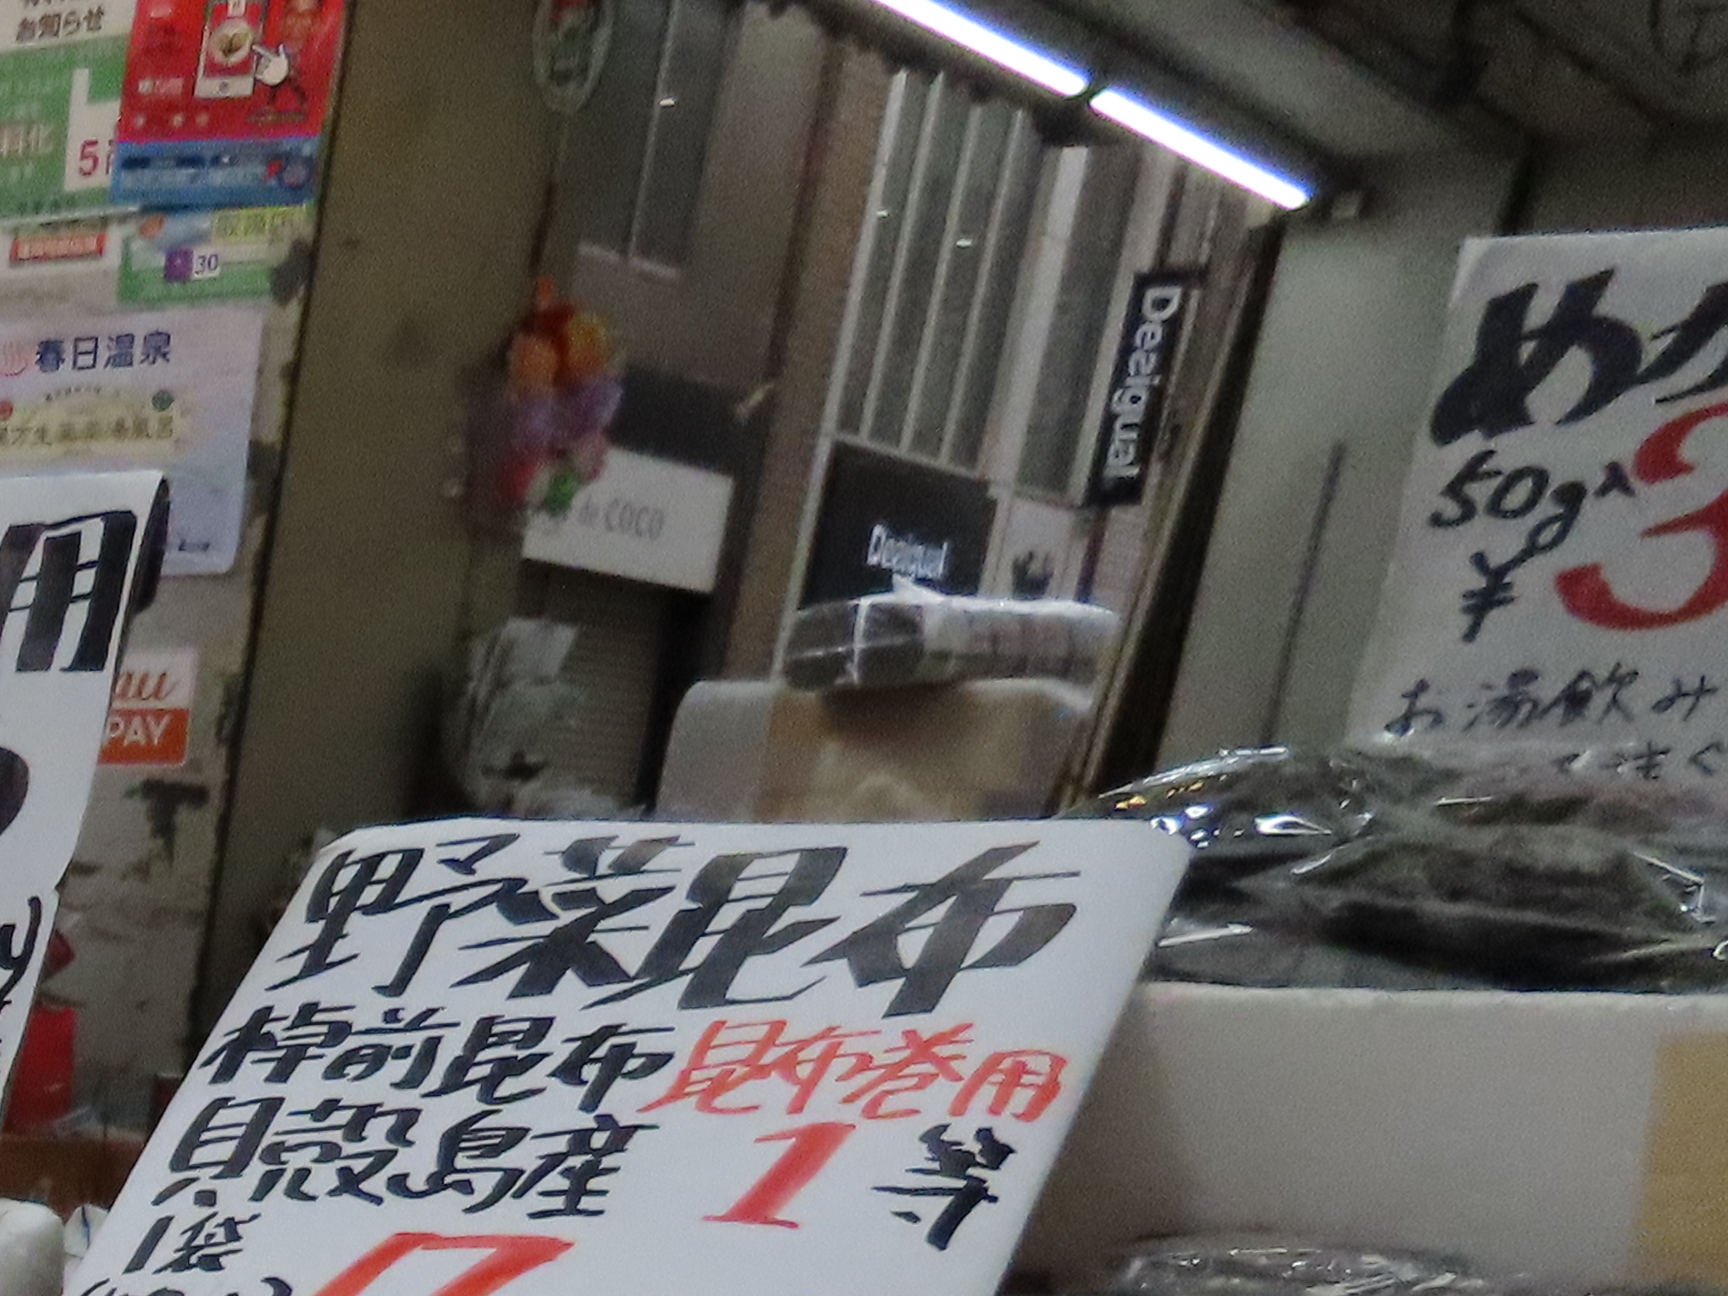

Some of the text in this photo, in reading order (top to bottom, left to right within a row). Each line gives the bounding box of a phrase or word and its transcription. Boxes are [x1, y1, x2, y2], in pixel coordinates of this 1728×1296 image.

[15, 5, 105, 43] お知らせ
[195, 253, 219, 276] 30
[34, 330, 172, 373] 春日温泉
[1101, 285, 1182, 490] Desigual
[604, 498, 666, 541] COCO
[106, 715, 171, 746] PAY
[266, 833, 1082, 1018] 野菜昆布
[635, 1019, 1069, 1122] 昆布巻用
[152, 1096, 659, 1218] 貝殻島産
[122, 1212, 262, 1275] 1袋
